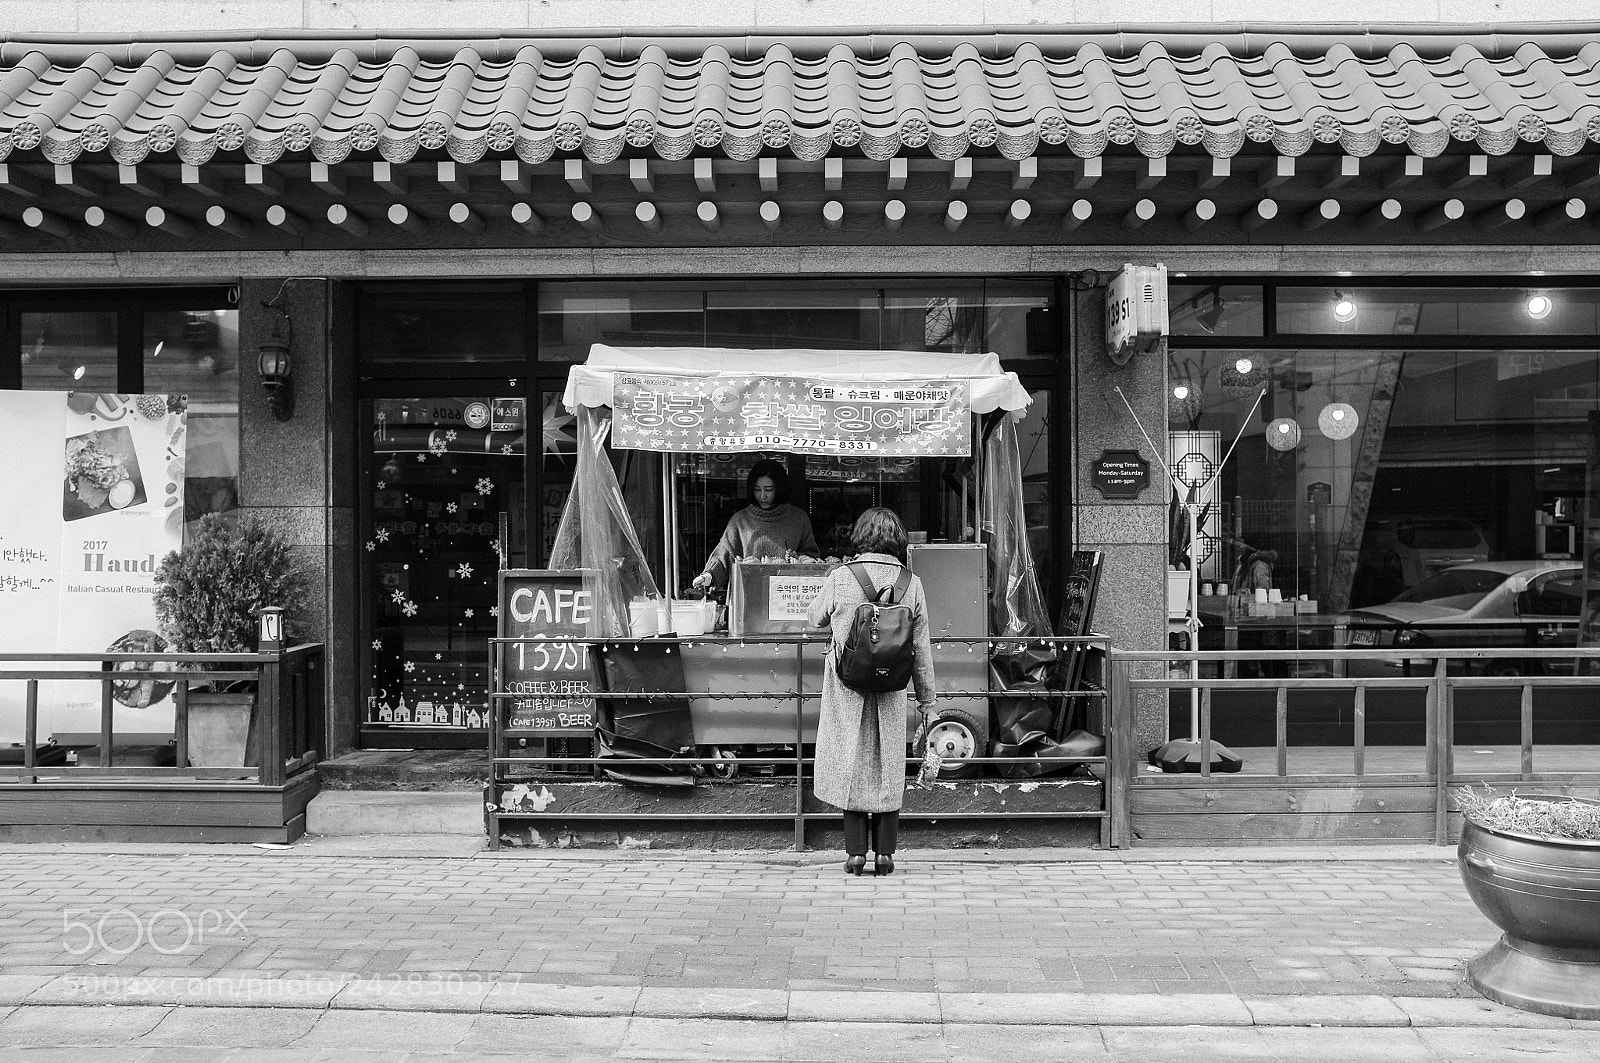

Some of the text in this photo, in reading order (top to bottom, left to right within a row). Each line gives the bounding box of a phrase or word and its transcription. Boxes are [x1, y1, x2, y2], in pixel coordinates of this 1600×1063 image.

[1121, 297, 1130, 320] ST
[812, 387, 949, 401] 통팥 슈크림 매운야채맛
[496, 407, 519, 417] 에스원
[739, 402, 827, 431] 찹쌀
[834, 405, 956, 435] 잉어빵
[755, 436, 873, 450] 010-7770-8331
[83, 540, 109, 550] 2017
[67, 585, 94, 593] Italian
[95, 585, 124, 593] Casual
[510, 587, 592, 625] CAFE
[505, 679, 590, 694] COFFEE & BEER
[558, 712, 593, 727] BEER
